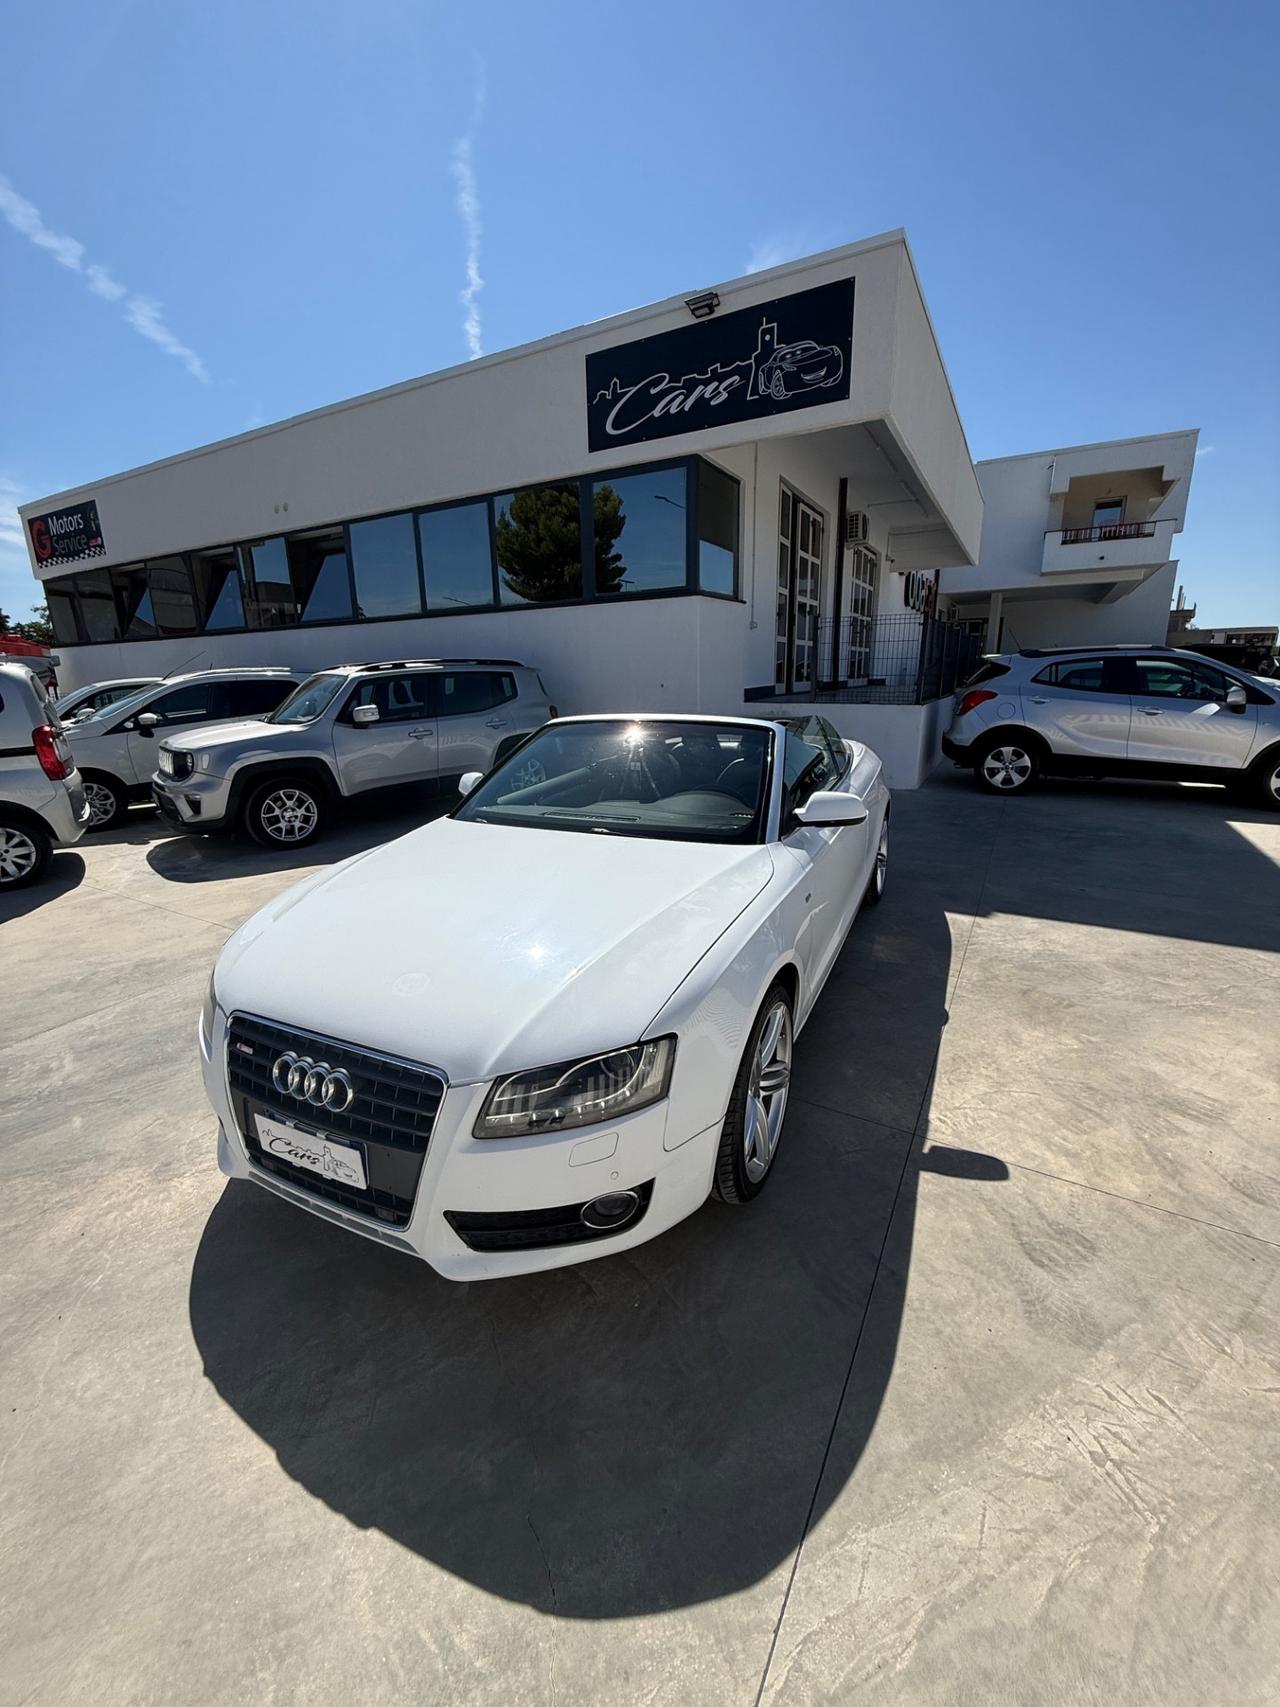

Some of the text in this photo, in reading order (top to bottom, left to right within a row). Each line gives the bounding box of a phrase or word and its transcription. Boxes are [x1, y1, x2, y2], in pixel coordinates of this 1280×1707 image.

[605, 373, 746, 436] Cars
[48, 513, 84, 536] Motors
[53, 533, 88, 555] Service
[269, 1137, 320, 1165] Cars
